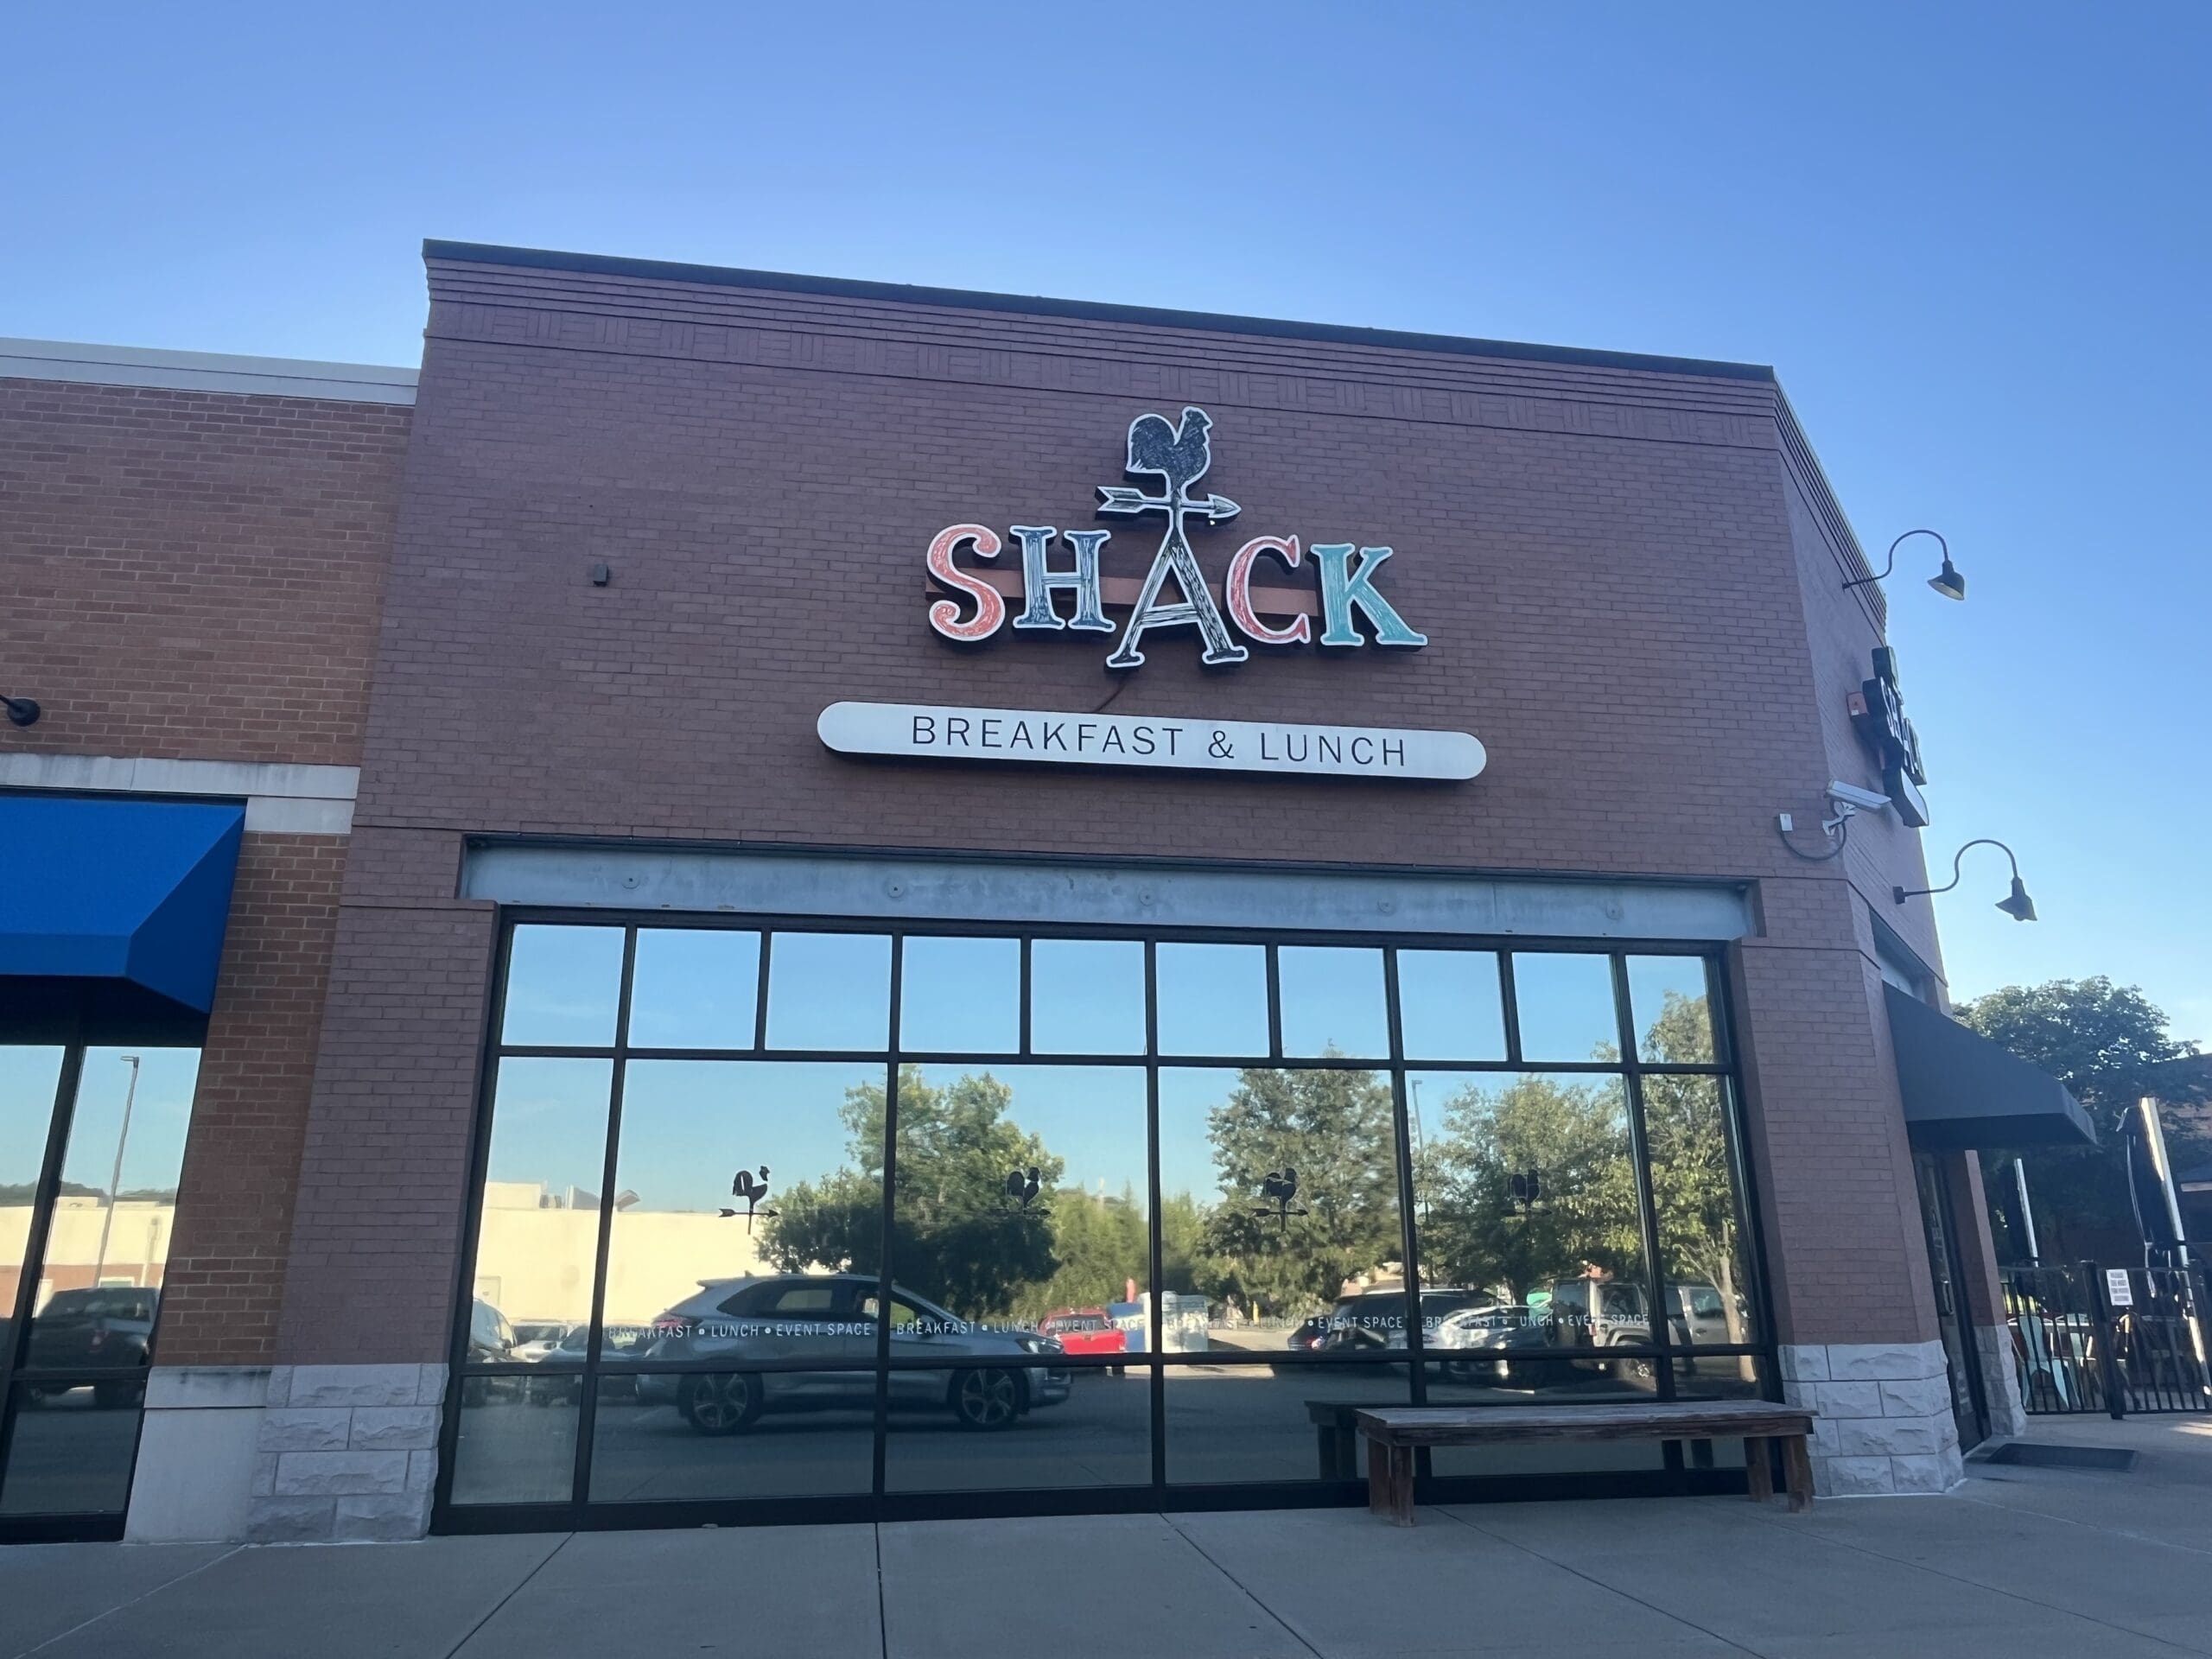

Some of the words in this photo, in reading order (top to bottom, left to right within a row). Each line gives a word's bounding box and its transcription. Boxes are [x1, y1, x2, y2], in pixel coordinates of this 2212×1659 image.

[926, 522, 1427, 669] SHACK
[912, 715, 1183, 757] BREAKFAST
[1207, 730, 1235, 760] &
[1259, 734, 1406, 766] LUNCH
[896, 1321, 976, 1335] BREAKFAST
[993, 1320, 1038, 1333] LUNCH
[1055, 1319, 1097, 1332] EVENT
[1318, 1317, 1357, 1329] EVENT
[1363, 1316, 1403, 1329] SPACE
[1611, 1313, 1649, 1326] SPACE
[710, 1325, 759, 1338] LUNCH
[776, 1324, 821, 1337] EVENT
[827, 1323, 871, 1337] SPACE
